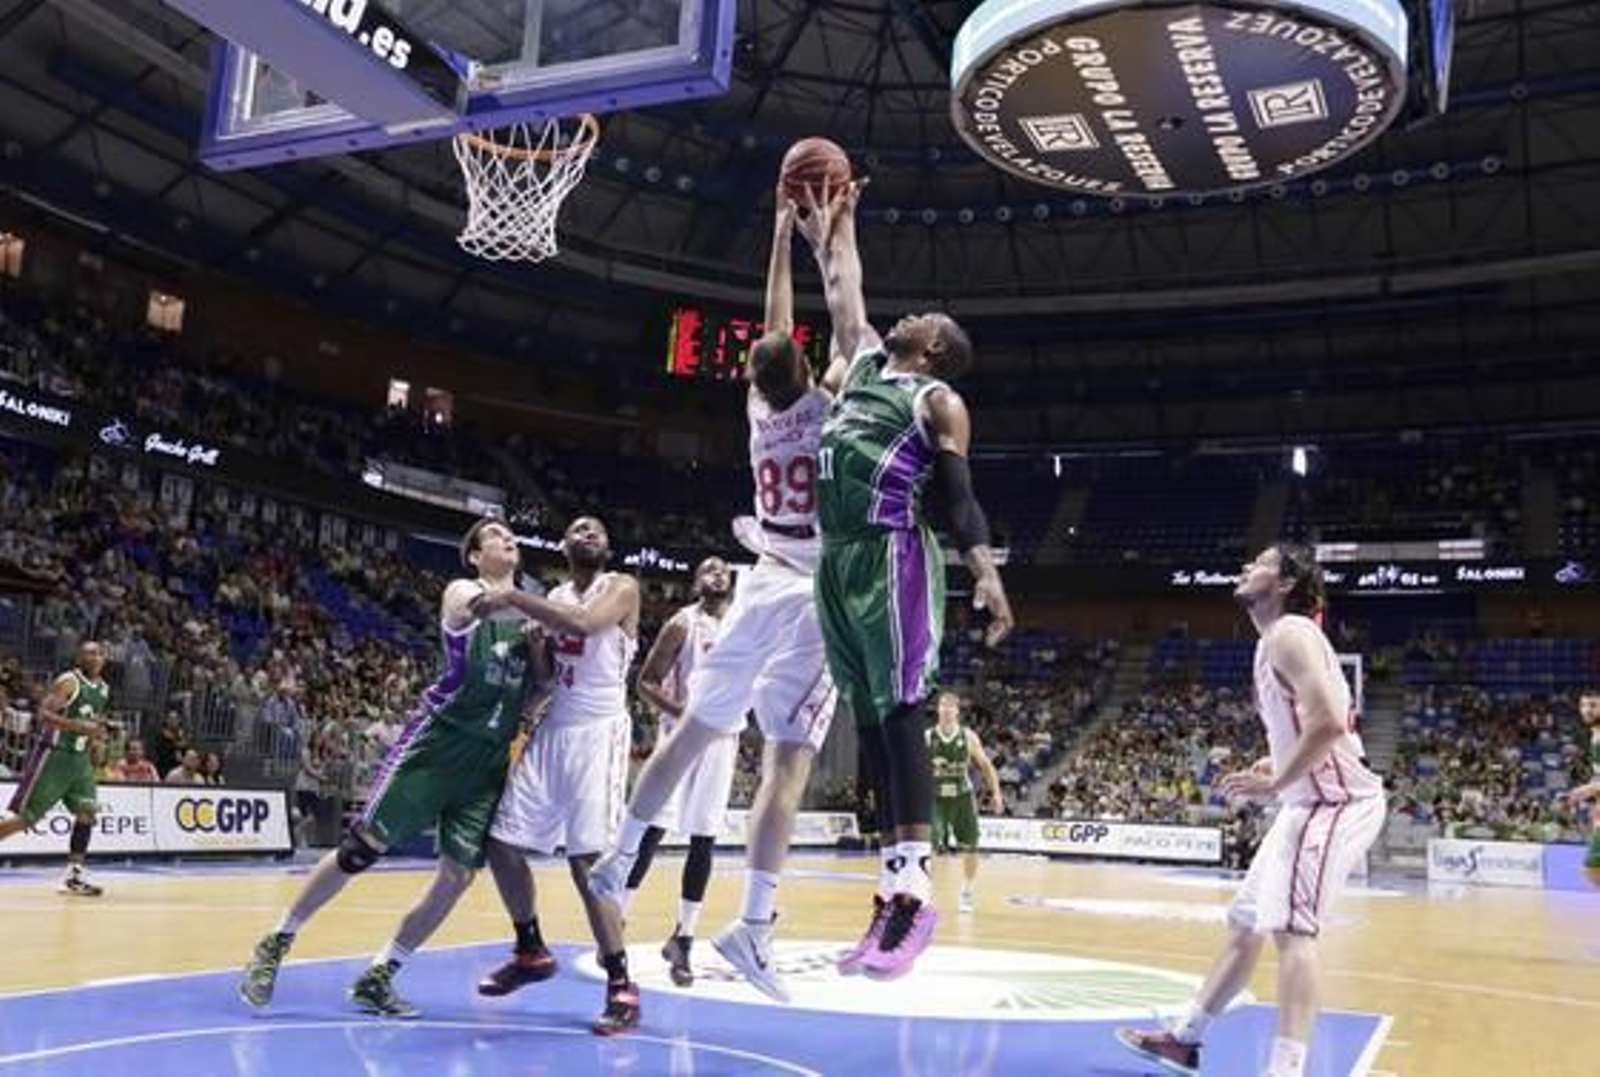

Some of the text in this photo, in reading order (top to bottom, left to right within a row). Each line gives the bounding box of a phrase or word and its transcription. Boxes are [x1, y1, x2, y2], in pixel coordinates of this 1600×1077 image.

[1064, 36, 1127, 106] GRUPO
[1101, 109, 1139, 131] LA
[1166, 16, 1232, 110] RESERVA
[758, 455, 816, 517] 89
[90, 815, 149, 835] EPE
